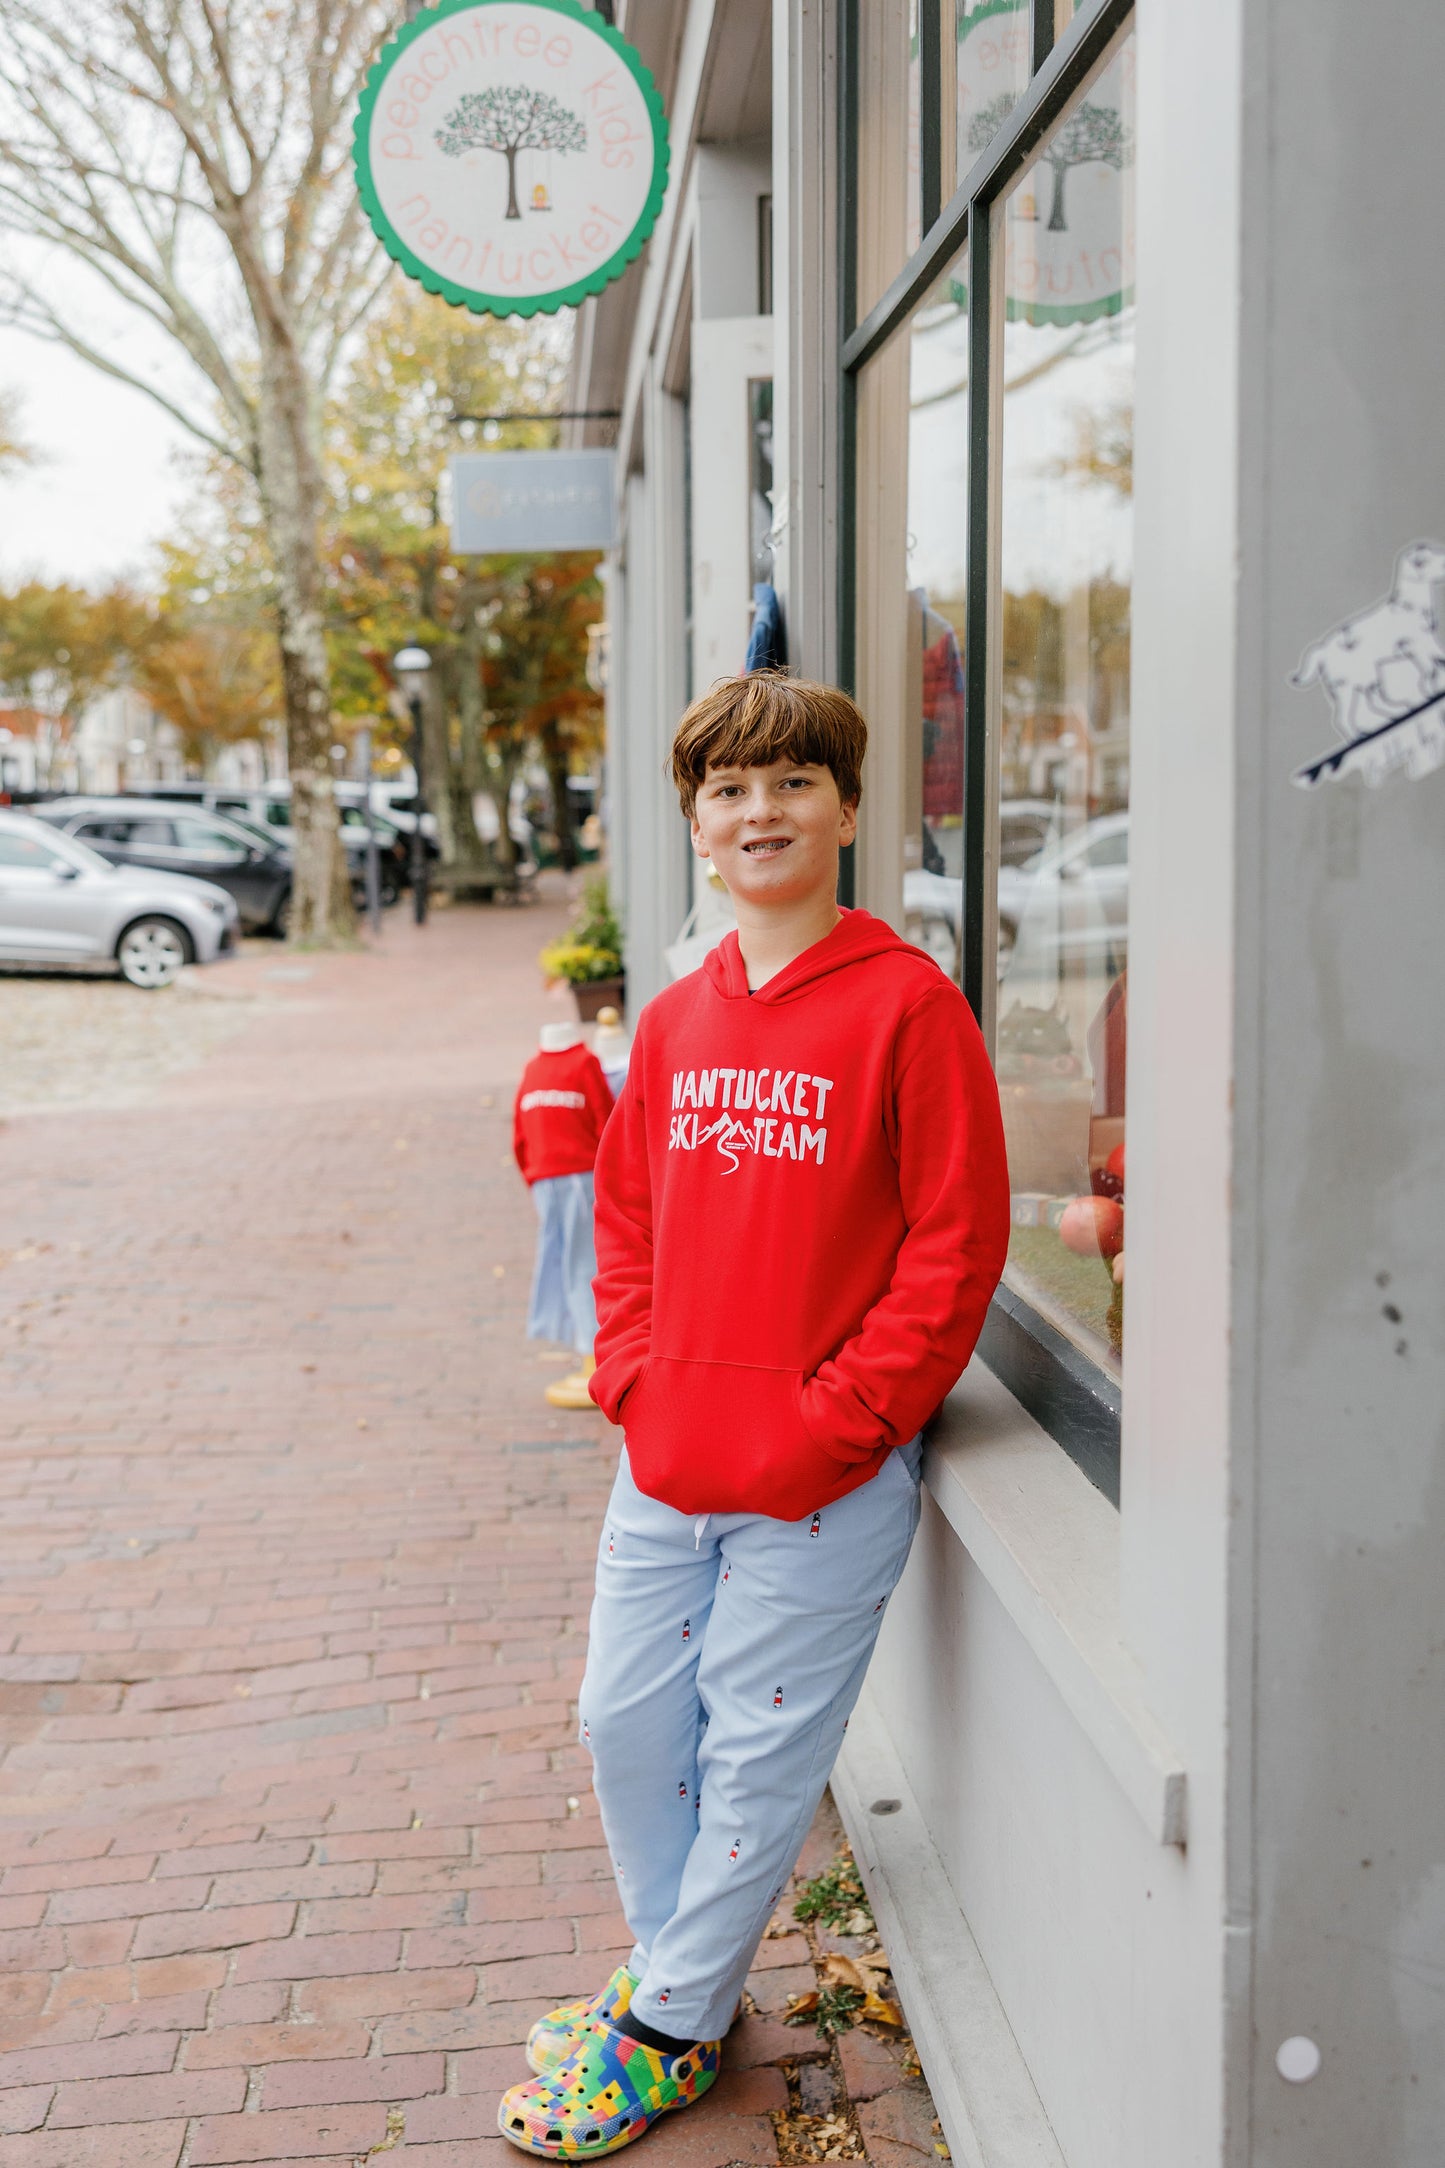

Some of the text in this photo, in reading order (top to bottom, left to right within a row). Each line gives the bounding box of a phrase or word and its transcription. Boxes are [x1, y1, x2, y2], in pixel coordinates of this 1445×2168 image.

[380, 17, 645, 169] peachtree kids
[397, 193, 624, 285] nantucket
[672, 1068, 834, 1120] NANTUCKET
[668, 1113, 827, 1165] SKI TEAM
